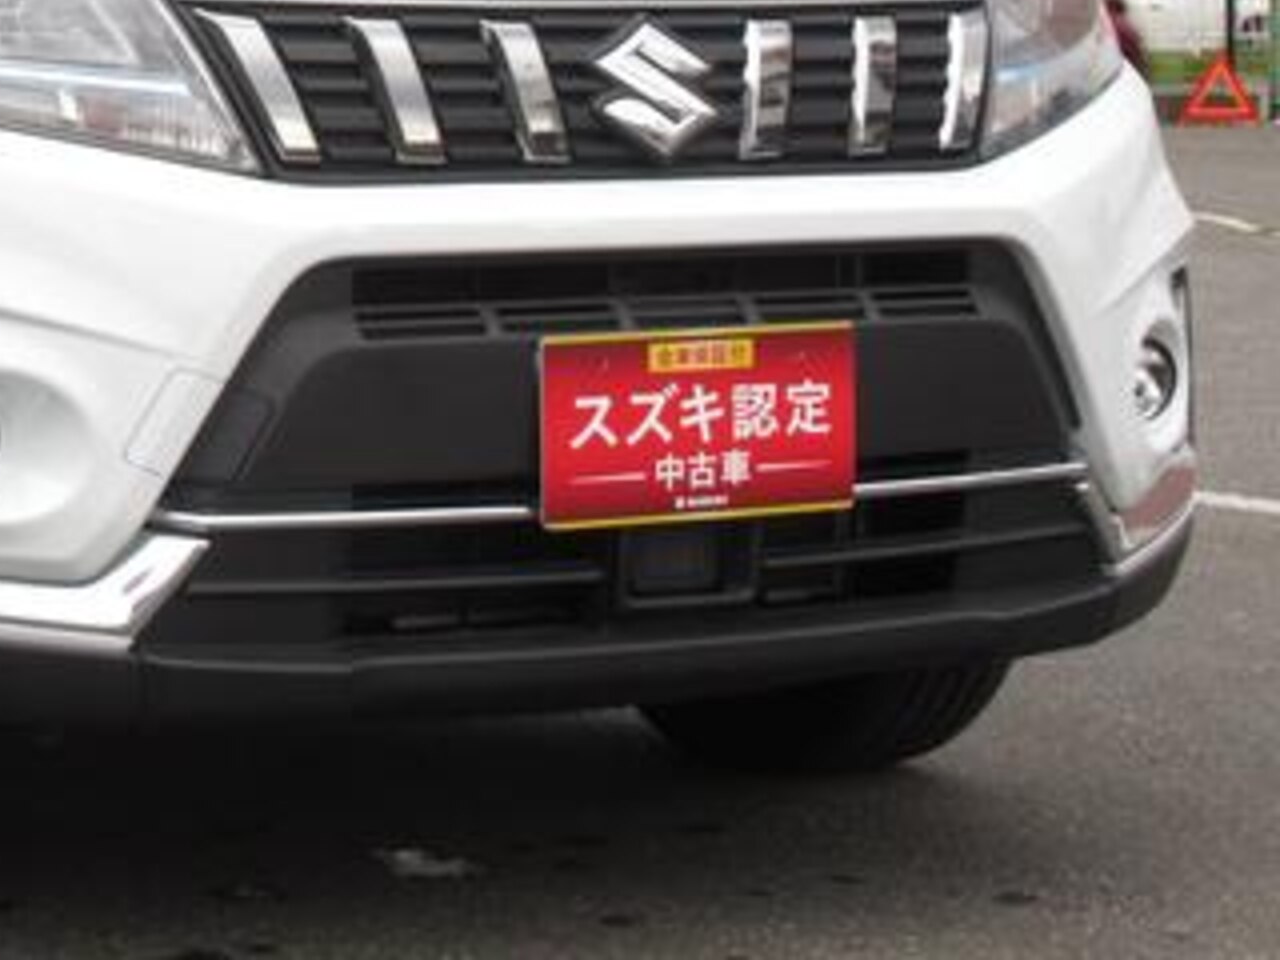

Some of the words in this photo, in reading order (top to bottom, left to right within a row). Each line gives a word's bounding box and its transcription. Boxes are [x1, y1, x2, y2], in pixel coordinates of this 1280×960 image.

[570, 380, 832, 450] スズキ認定
[655, 448, 752, 492] 中古車
